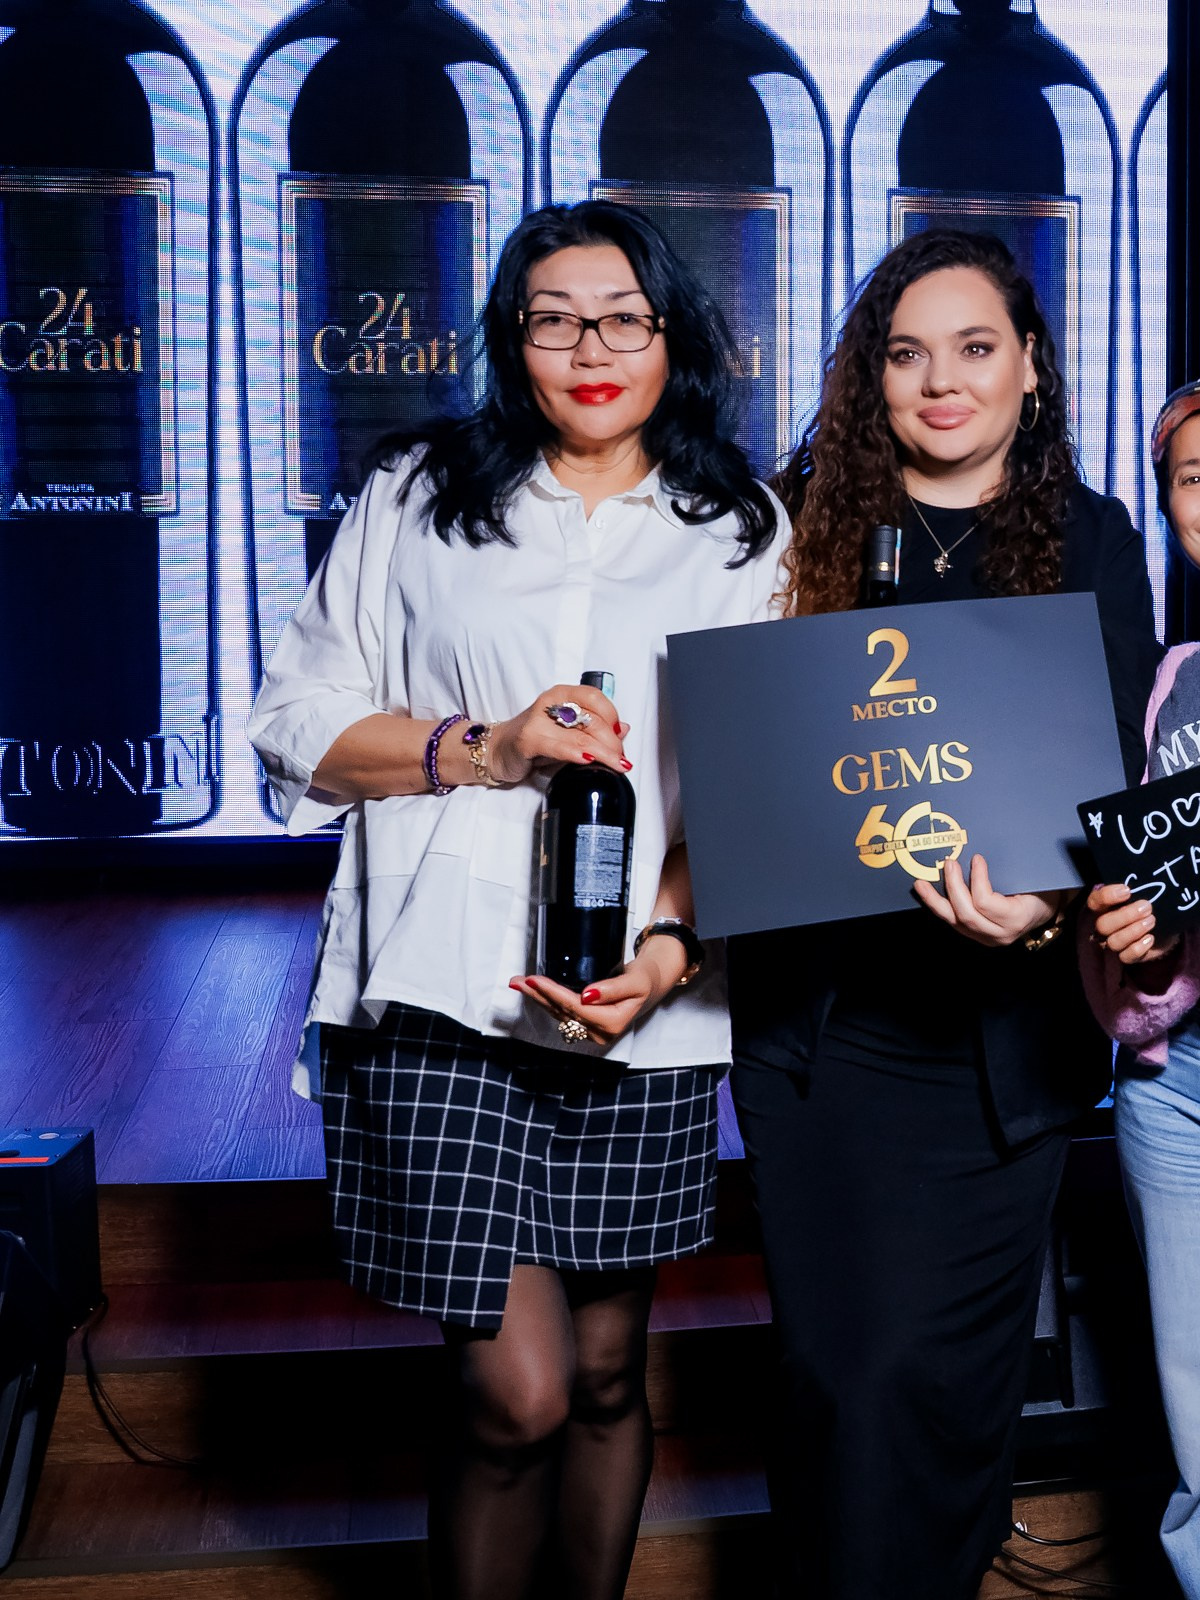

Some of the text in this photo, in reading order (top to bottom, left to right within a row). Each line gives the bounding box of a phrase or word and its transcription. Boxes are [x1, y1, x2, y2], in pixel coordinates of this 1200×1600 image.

[39, 286, 95, 335] 24
[358, 292, 411, 339] 24
[0, 321, 143, 372] Carati
[312, 325, 458, 374] Carati
[866, 627, 918, 697] 2
[851, 695, 938, 722] МЕСТО
[831, 741, 974, 795] GEMS
